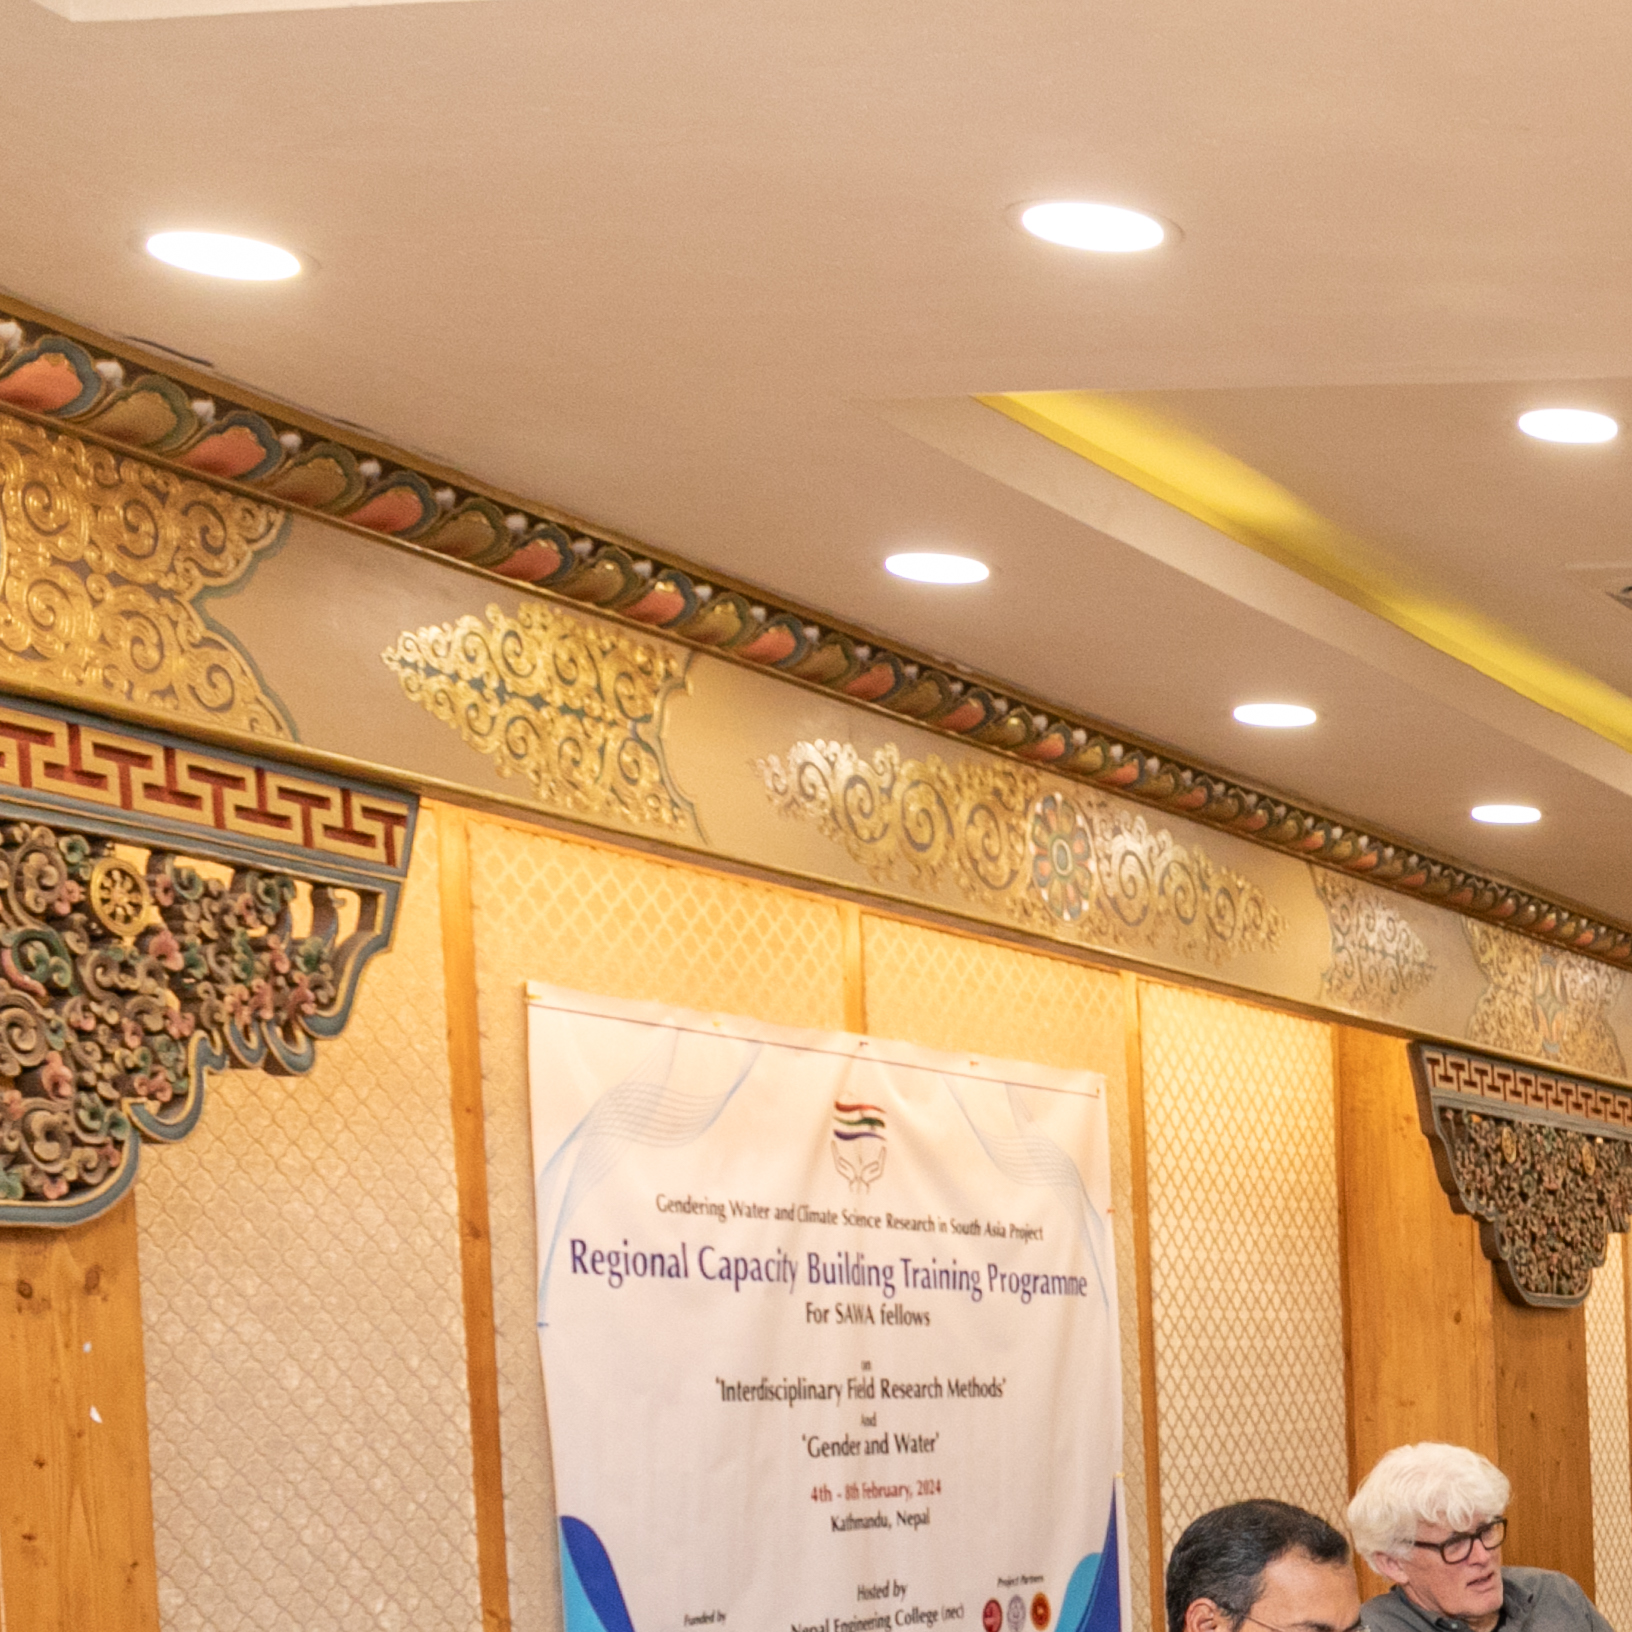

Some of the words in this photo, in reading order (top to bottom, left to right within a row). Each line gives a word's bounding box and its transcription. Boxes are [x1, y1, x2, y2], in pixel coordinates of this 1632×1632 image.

[656, 1193, 727, 1223] Gendering
[729, 1199, 770, 1218] Water
[774, 1203, 795, 1221] and
[797, 1204, 838, 1226] Climate
[841, 1208, 881, 1229] Science
[886, 1212, 935, 1233] Research
[938, 1216, 947, 1233] in
[950, 1217, 981, 1238] South
[984, 1220, 1006, 1239] Asia
[1009, 1223, 1044, 1244] Project
[570, 1238, 690, 1289] Regional
[697, 1244, 799, 1295] Capacity
[807, 1251, 896, 1300] Building
[900, 1257, 983, 1302] Training
[987, 1263, 1088, 1305] Programme
[805, 1301, 828, 1324] For
[835, 1302, 875, 1326] SAWA
[880, 1303, 930, 1327] fellows
[847, 1376, 875, 1400] Field
[880, 1377, 943, 1400] Research
[863, 1432, 889, 1455] and
[810, 1483, 832, 1502] 4th
[916, 1478, 941, 1496] 2024
[896, 1507, 930, 1531] Nepal
[856, 1580, 889, 1602] Hosted
[892, 1579, 908, 1602] by
[895, 1606, 939, 1631] College
[941, 1602, 965, 1622] (nec)
